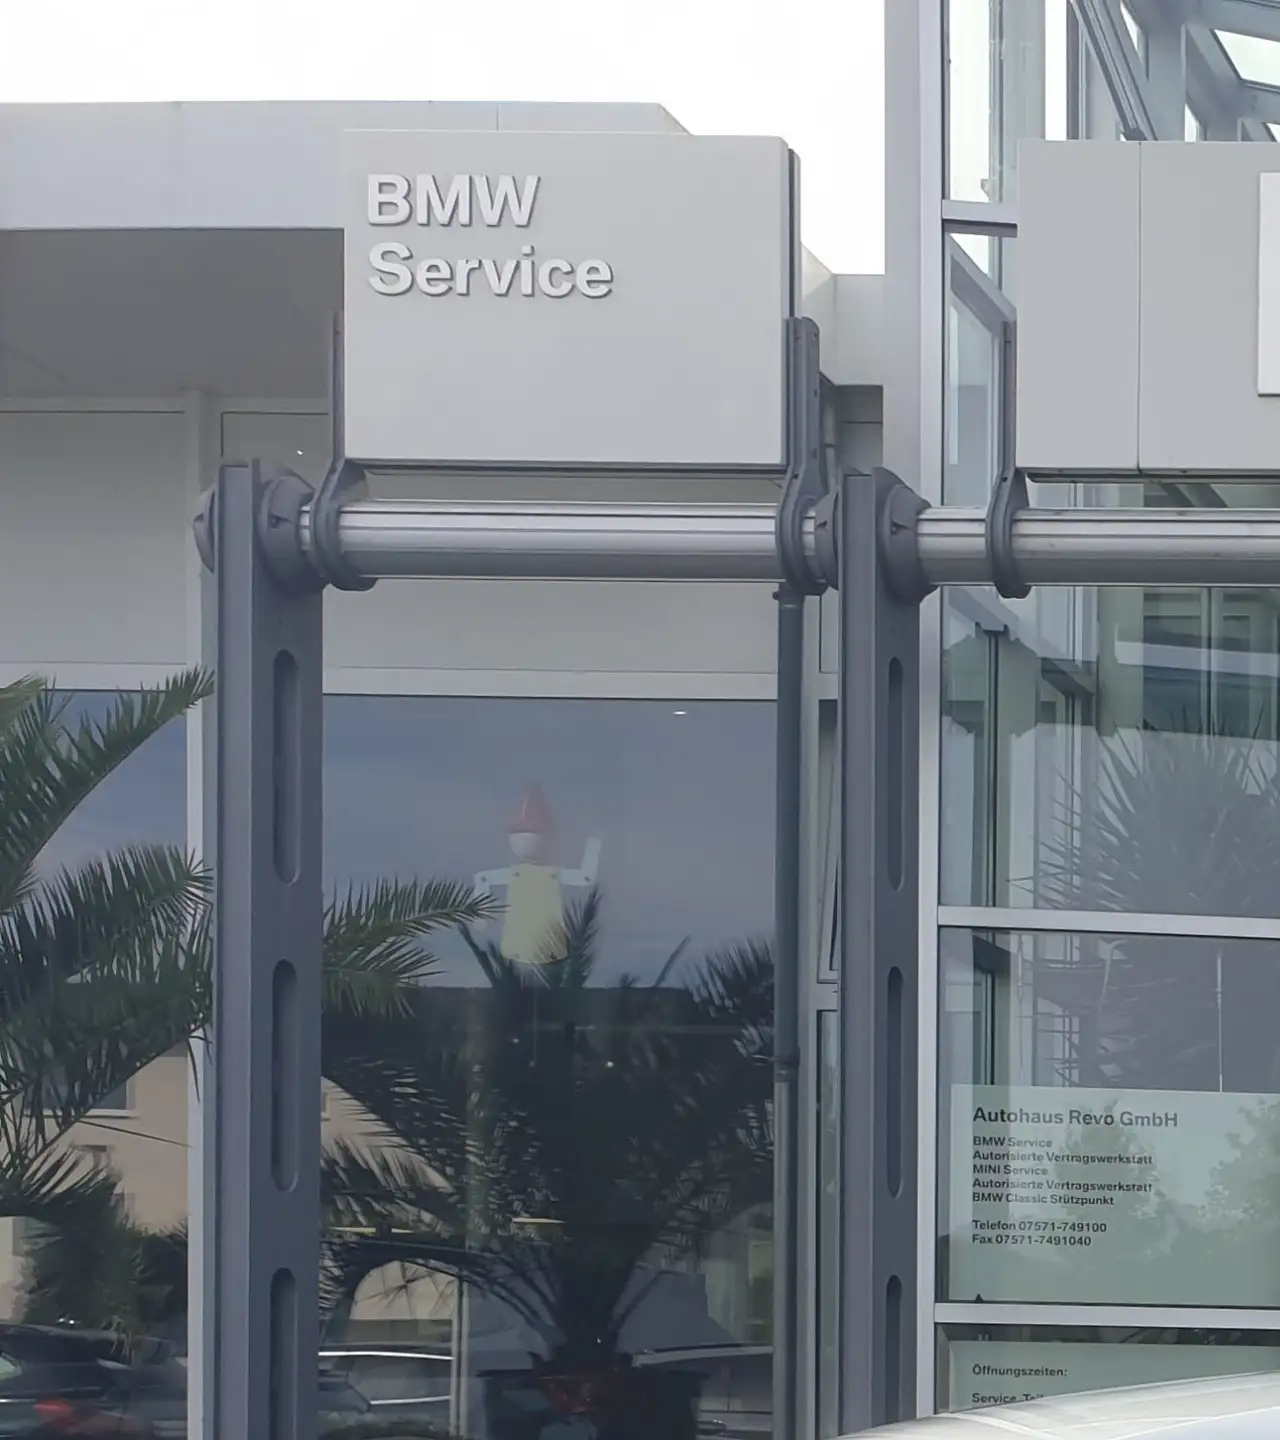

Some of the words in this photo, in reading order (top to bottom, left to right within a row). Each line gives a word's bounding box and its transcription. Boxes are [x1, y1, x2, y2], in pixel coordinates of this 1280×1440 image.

[367, 173, 541, 229] BMW
[367, 242, 614, 299] Service
[972, 1107, 1064, 1125] Autohaus
[1068, 1109, 1115, 1126] Revo
[1119, 1110, 1179, 1128] GmbH
[972, 1135, 1005, 1147] BMW
[1007, 1137, 1053, 1148] Service
[972, 1150, 1044, 1162] Autorisierte
[1046, 1152, 1153, 1165] Vertragswerkstatt
[972, 1164, 1001, 1175] MINI
[1003, 1165, 1049, 1176] Service
[972, 1178, 1044, 1190] Autorisierte
[1046, 1180, 1153, 1193] Vertragswerkstatt
[972, 1192, 1004, 1203] BMW
[1005, 1193, 1049, 1204] Classic
[1050, 1193, 1115, 1206] Stützpunkt
[972, 1219, 1016, 1231] Telefon
[1018, 1220, 1108, 1233] 07571-749100
[972, 1233, 993, 1245] Fax
[994, 1234, 1092, 1246] 07571-7491040
[972, 1363, 1068, 1378] Öffnungszeiten:
